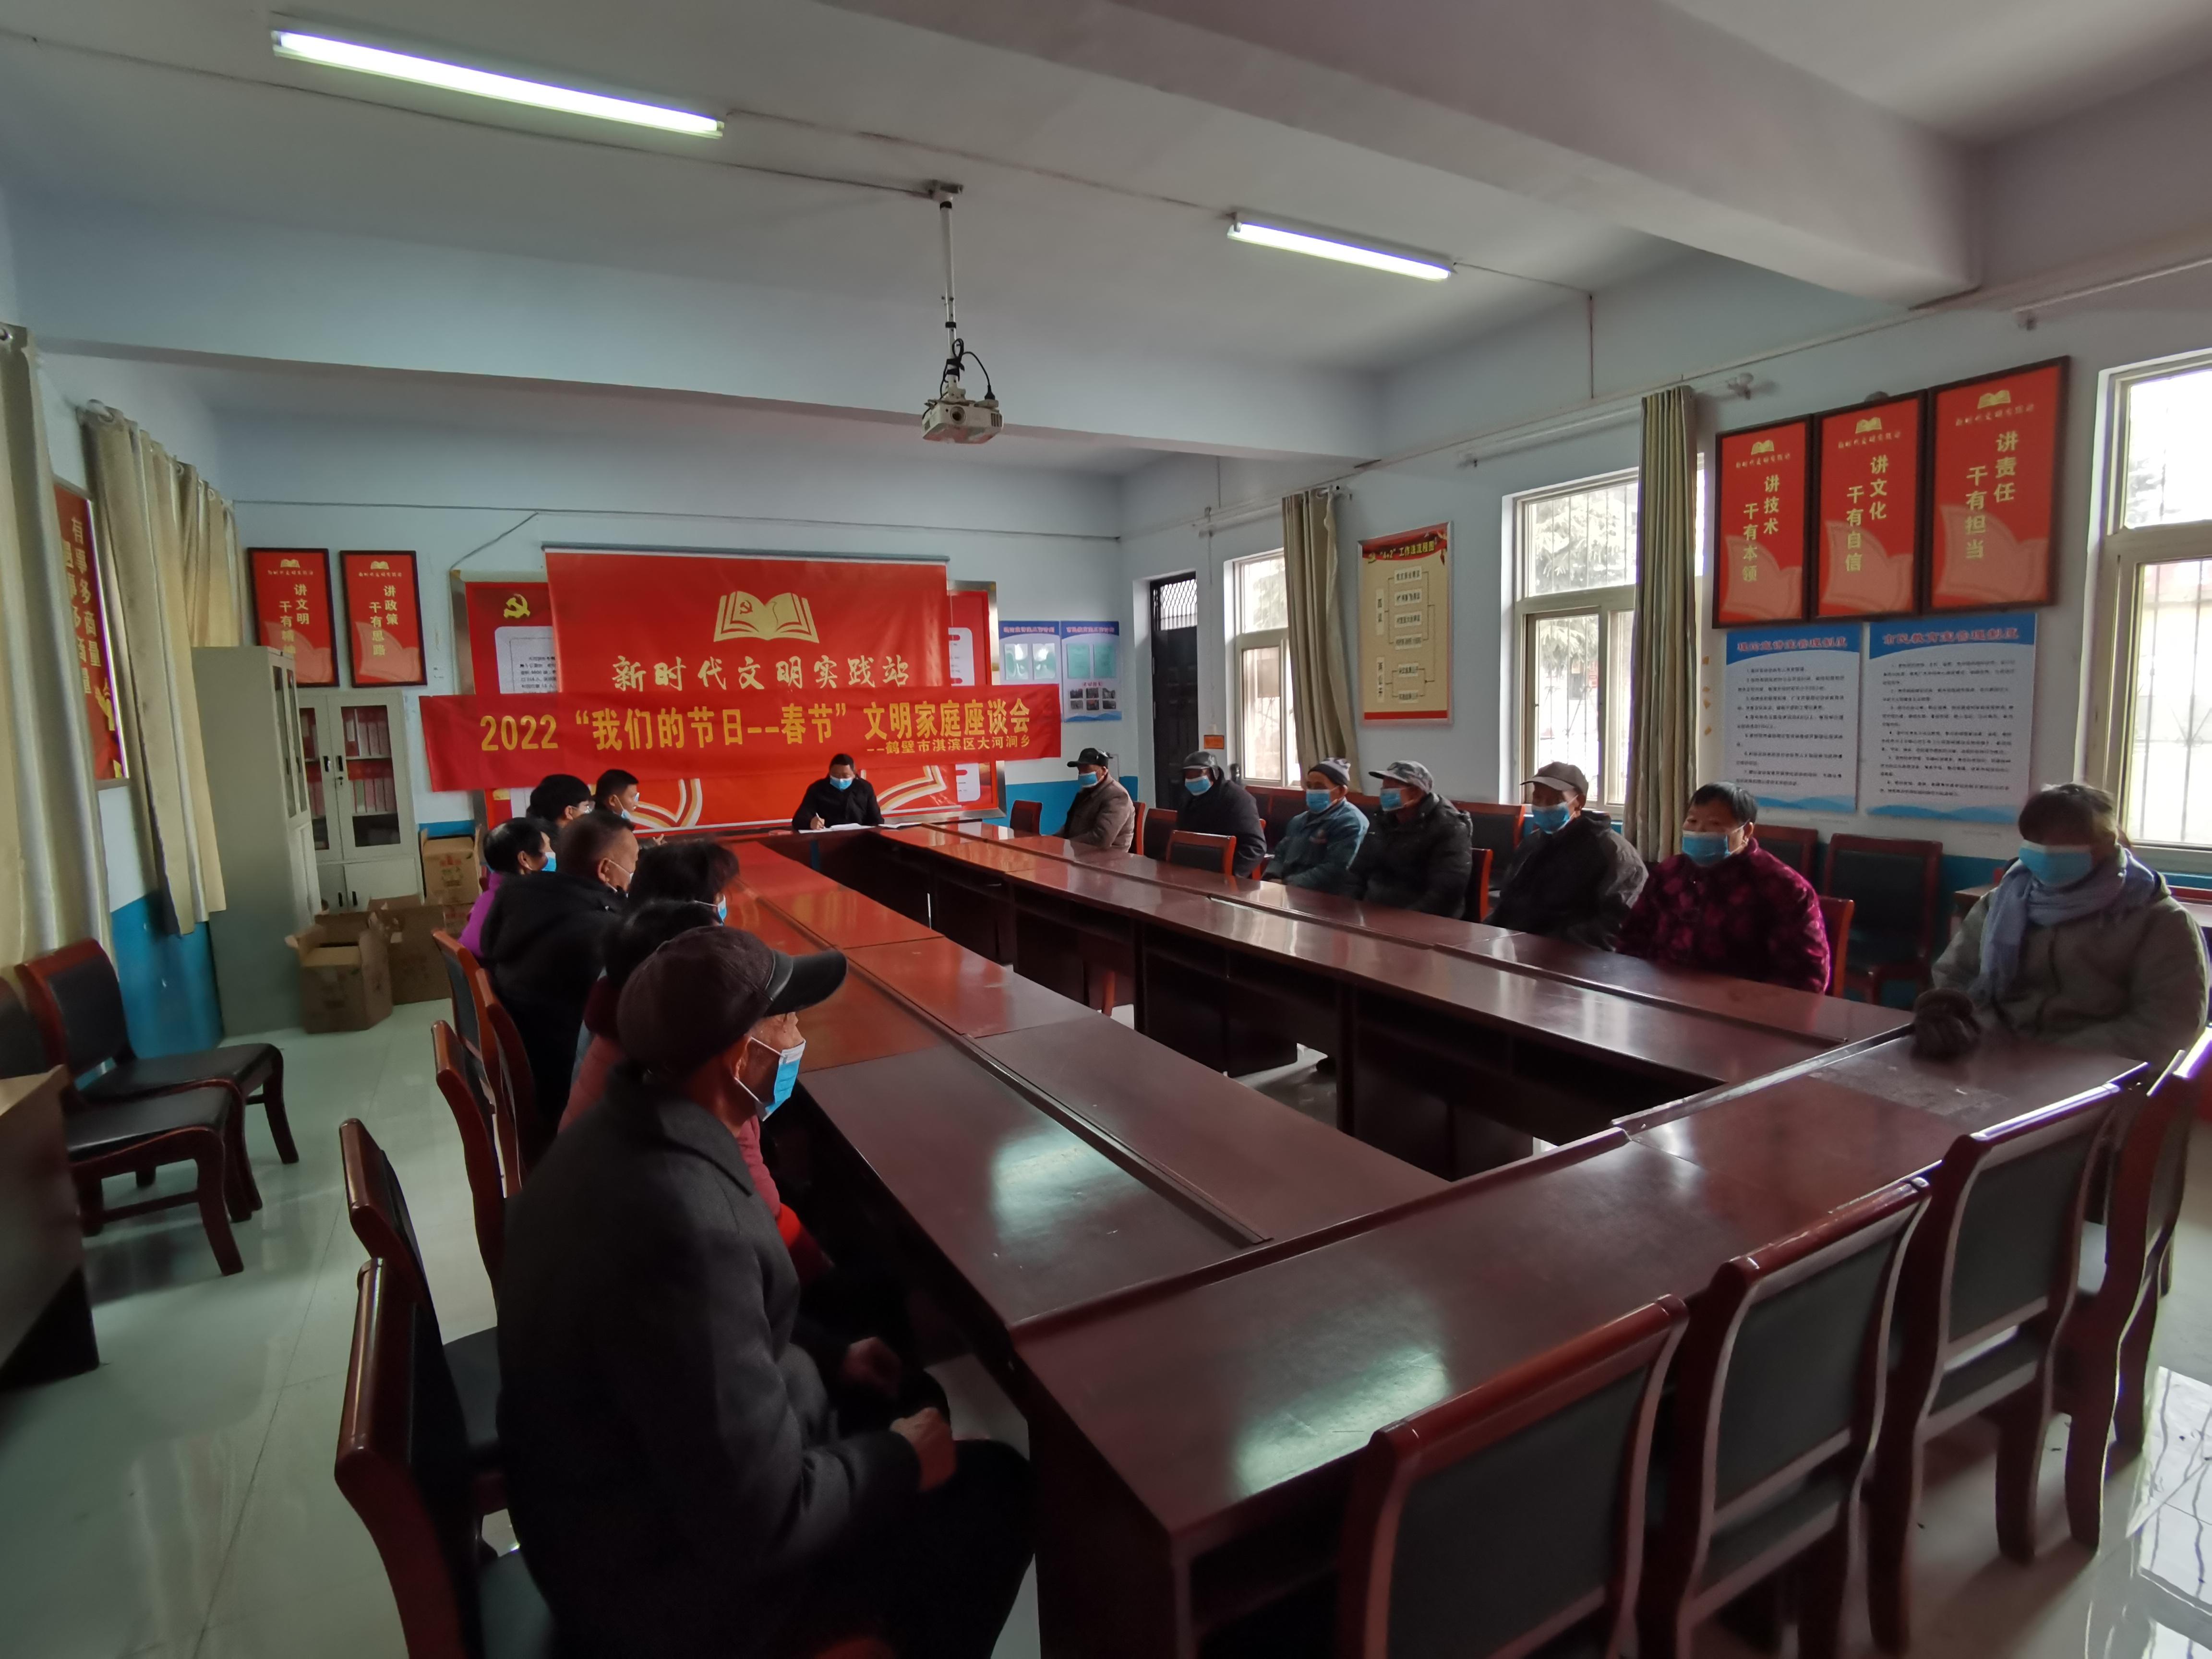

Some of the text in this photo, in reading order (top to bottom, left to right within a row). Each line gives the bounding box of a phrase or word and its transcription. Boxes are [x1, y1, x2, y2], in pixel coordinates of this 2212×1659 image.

[1869, 456, 1889, 520] 讲文化
[1994, 431, 2019, 503] 讲责任
[1763, 474, 1779, 535] 讲技术
[1845, 485, 1864, 572] 干有自信
[1965, 466, 1988, 560] 干有担当
[1742, 503, 1759, 582] 干有本领
[294, 584, 310, 625] 讲文明
[384, 585, 398, 625] 讲政策
[612, 655, 910, 692] 新时代文明实践站
[480, 714, 558, 751] 2022
[863, 698, 1030, 740] 文明家庭座谈会
